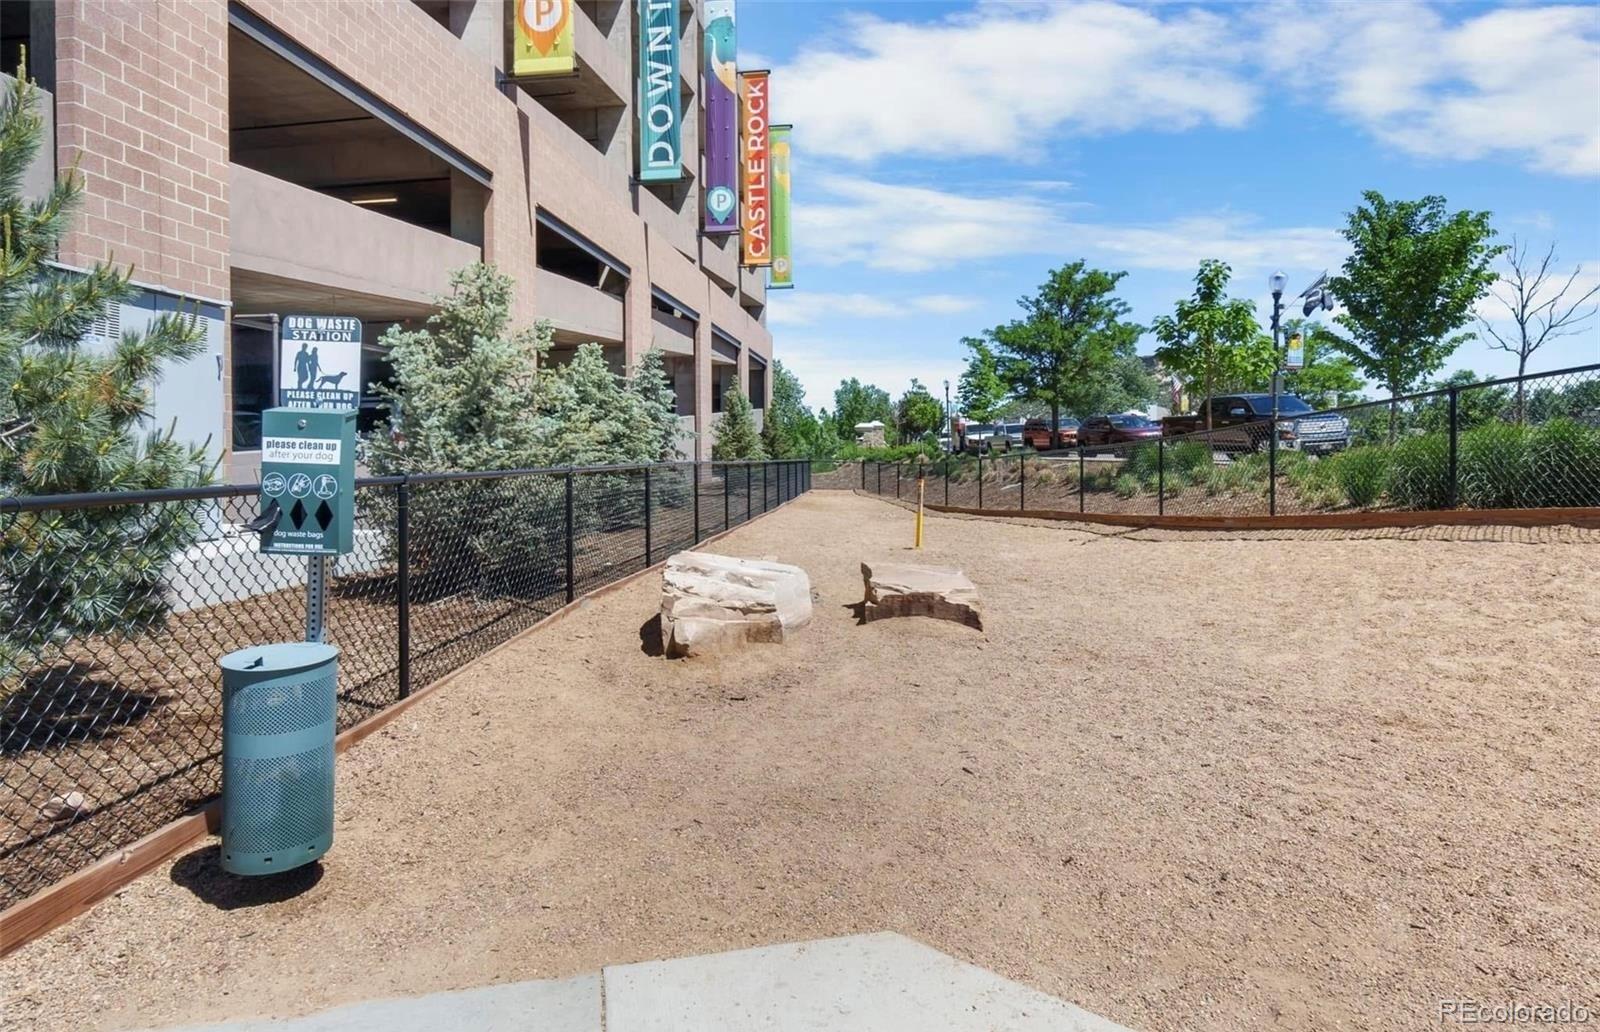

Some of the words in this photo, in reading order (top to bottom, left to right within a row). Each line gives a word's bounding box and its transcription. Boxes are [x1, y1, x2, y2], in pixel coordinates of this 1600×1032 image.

[536, 0, 553, 25] P
[747, 81, 764, 151] ROCK
[717, 194, 727, 208] P
[748, 157, 766, 257] CASTLE
[288, 317, 312, 328] DOG
[316, 318, 356, 330] WASTE
[287, 390, 315, 399] PLEASE
[316, 391, 341, 400] CLEAN
[343, 392, 354, 401] UP
[266, 440, 297, 449] please
[298, 441, 324, 450] clean
[325, 443, 337, 451] up
[269, 449, 290, 458] after
[292, 451, 313, 461] your
[315, 451, 334, 462] dog
[273, 530, 286, 539] dog
[307, 531, 324, 540] bags
